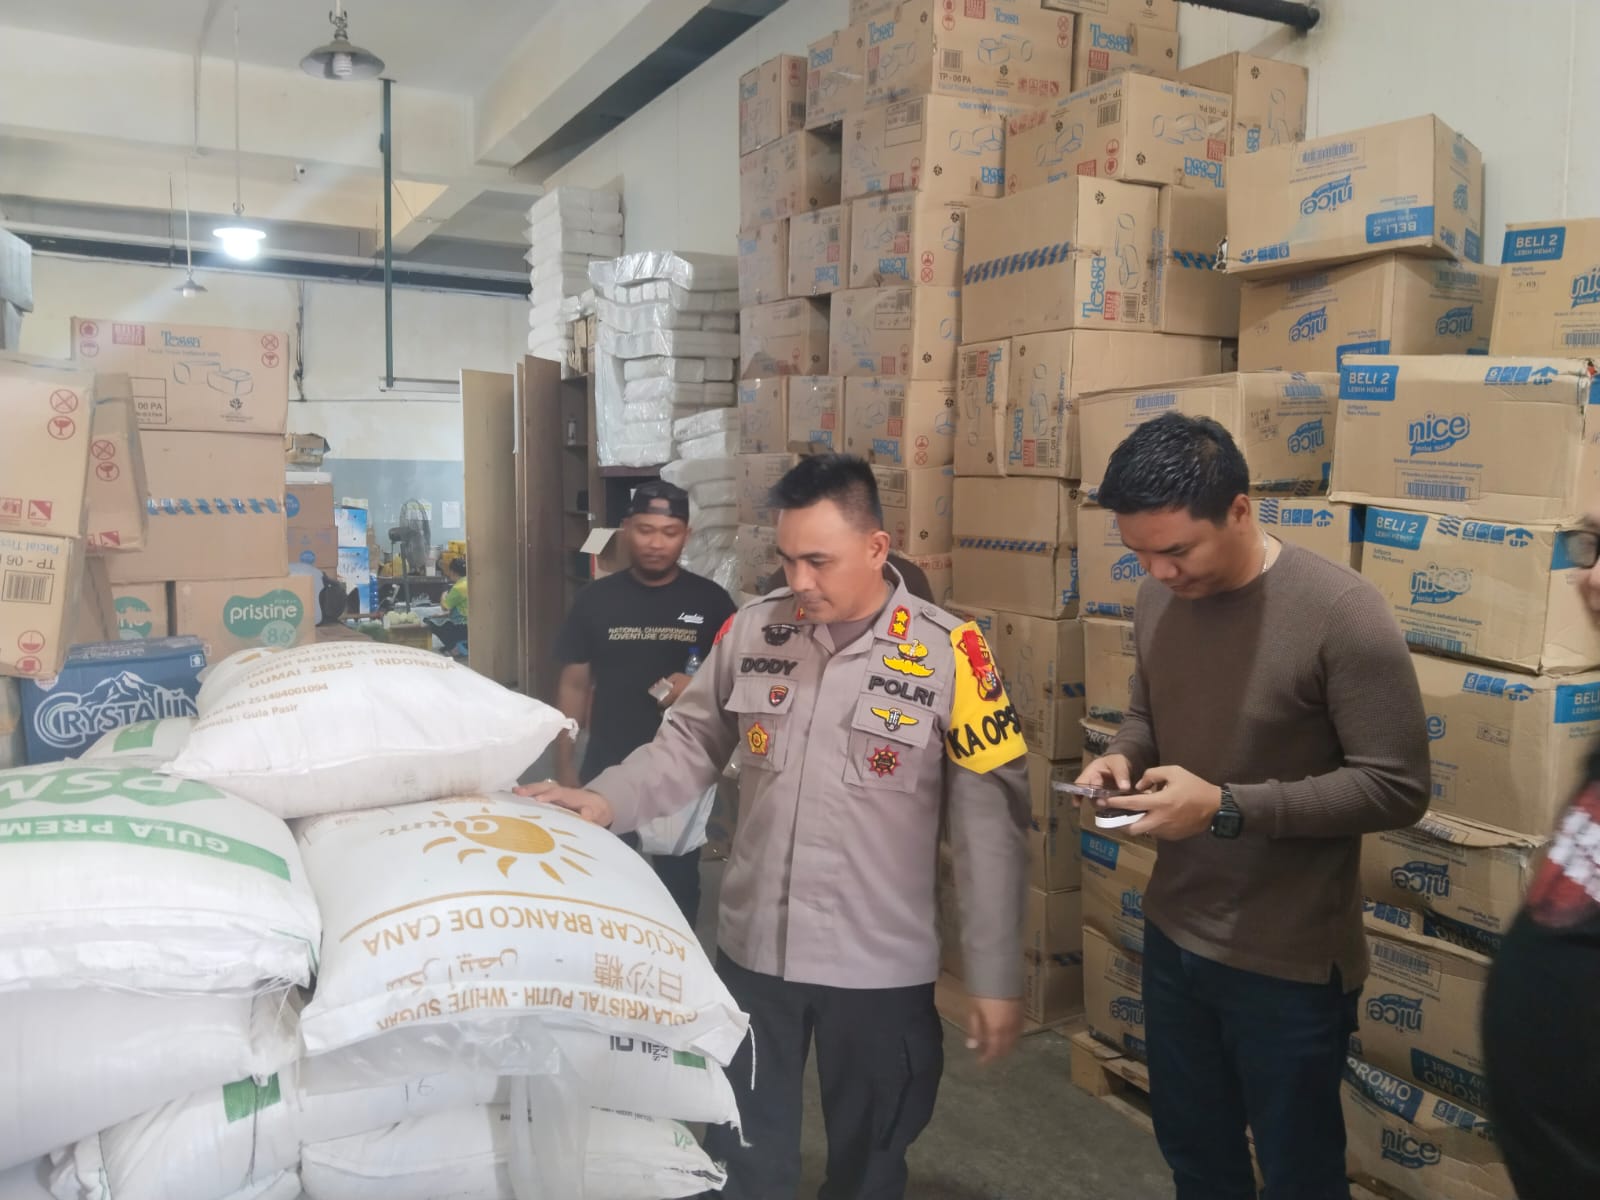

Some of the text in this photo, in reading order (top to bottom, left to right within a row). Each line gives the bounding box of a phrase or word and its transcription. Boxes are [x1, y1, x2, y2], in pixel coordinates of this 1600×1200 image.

[1089, 23, 1133, 53] Tessa
[1184, 156, 1225, 189] Tessa
[1300, 182, 1353, 217] nice
[1372, 220, 1417, 237] BELI 2
[1516, 234, 1558, 248] BELI 2
[1081, 255, 1107, 318] Tessa
[1289, 313, 1327, 341] nice
[1349, 372, 1391, 385] BELI 2
[1288, 430, 1325, 455] nice
[1409, 412, 1471, 446] nice
[1376, 516, 1419, 533] BELI 2
[1509, 540, 1529, 548] UP
[36, 558, 56, 570] TP
[229, 601, 297, 625] pristine
[248, 668, 302, 689] DUMAI
[374, 657, 456, 671] INDONESIA
[739, 656, 798, 676] DODY
[867, 675, 936, 707] POLRI
[271, 703, 299, 715] Pasir
[947, 722, 985, 760] KA
[128, 822, 230, 854] GULA
[1391, 867, 1450, 900] nice
[361, 906, 687, 962] AÇÚCAR BRANCO DE CANA
[594, 951, 684, 1003] 白沙糖
[446, 986, 509, 1011] WHITE
[522, 985, 574, 1010] PUTIH
[578, 990, 650, 1021] KRISTAL
[1368, 1001, 1423, 1034] nice
[1347, 1055, 1412, 1101] PROMO
[1381, 1127, 1441, 1165] nice
